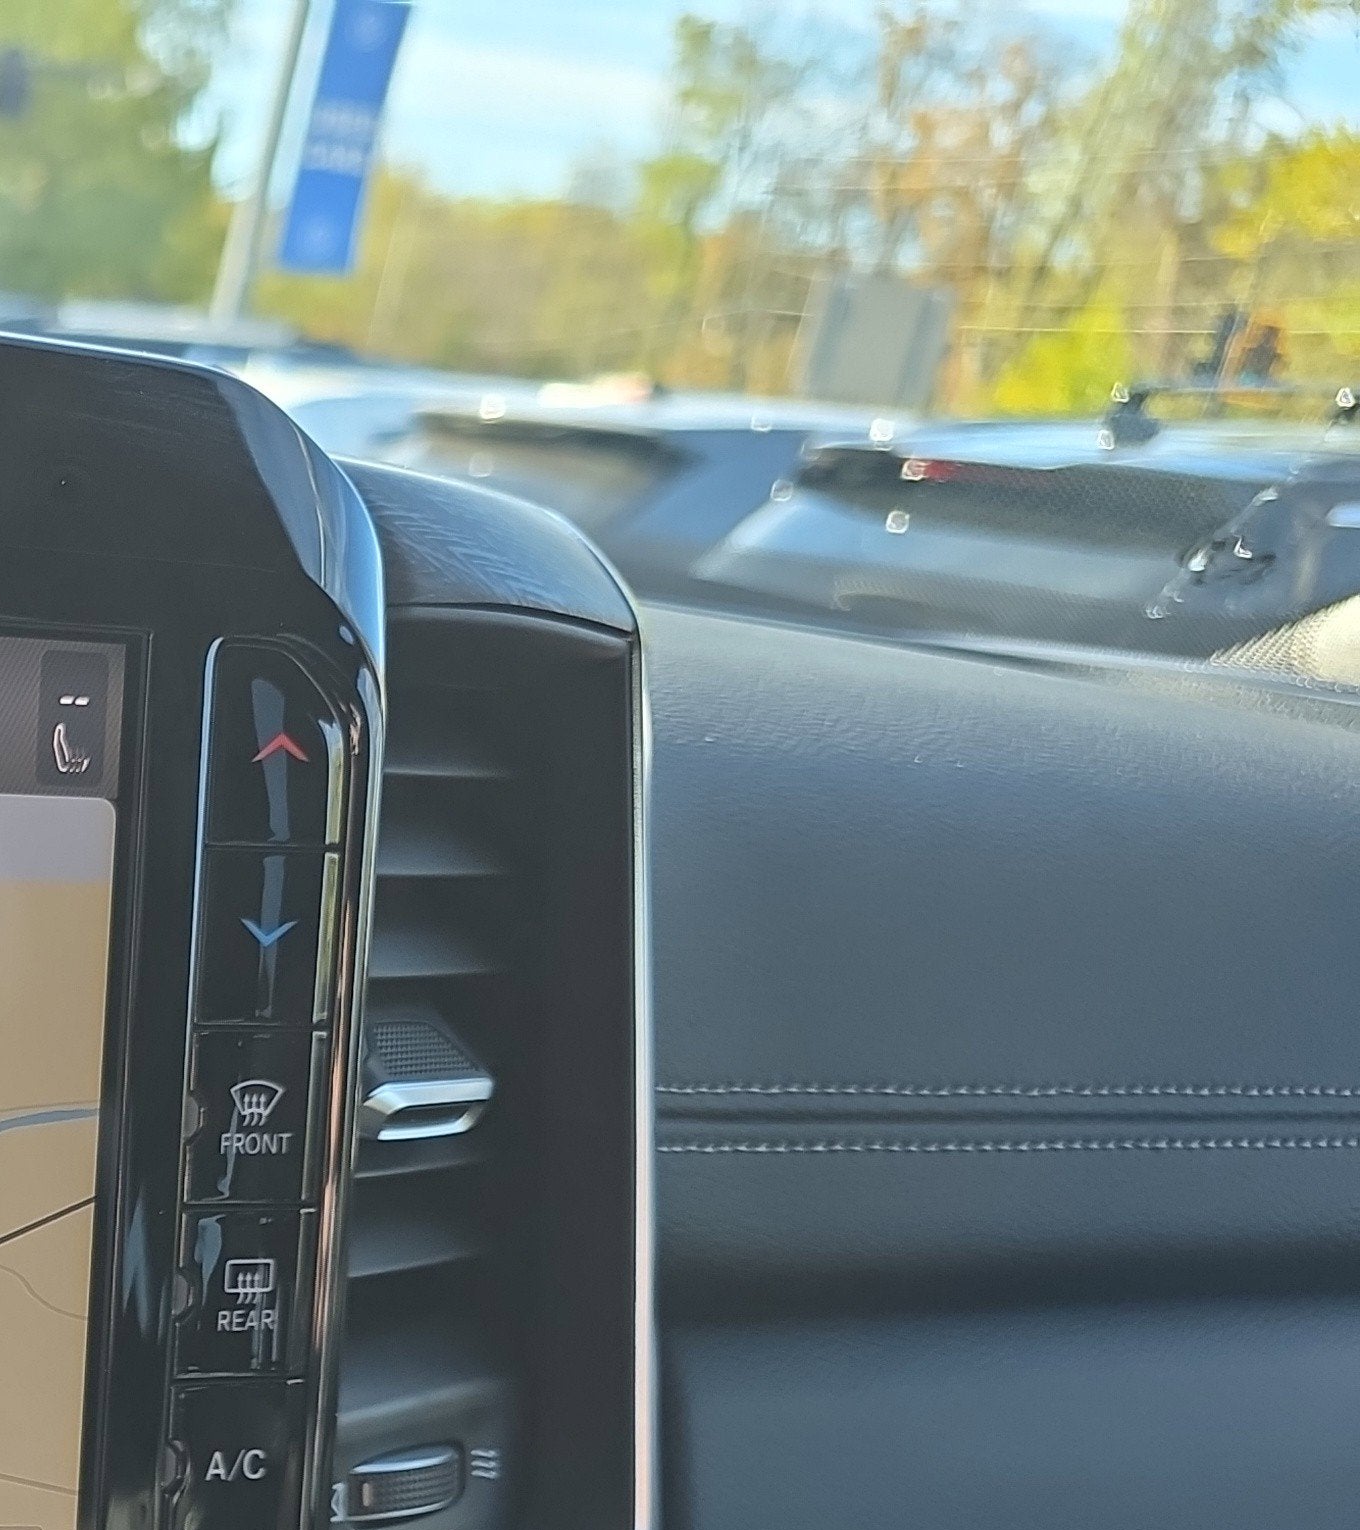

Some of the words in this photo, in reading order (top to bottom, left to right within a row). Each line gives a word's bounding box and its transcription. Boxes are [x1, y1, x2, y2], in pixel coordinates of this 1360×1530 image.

[220, 1132, 293, 1156] FRONT
[217, 1309, 275, 1333] REAR
[205, 1448, 267, 1482] A/C
